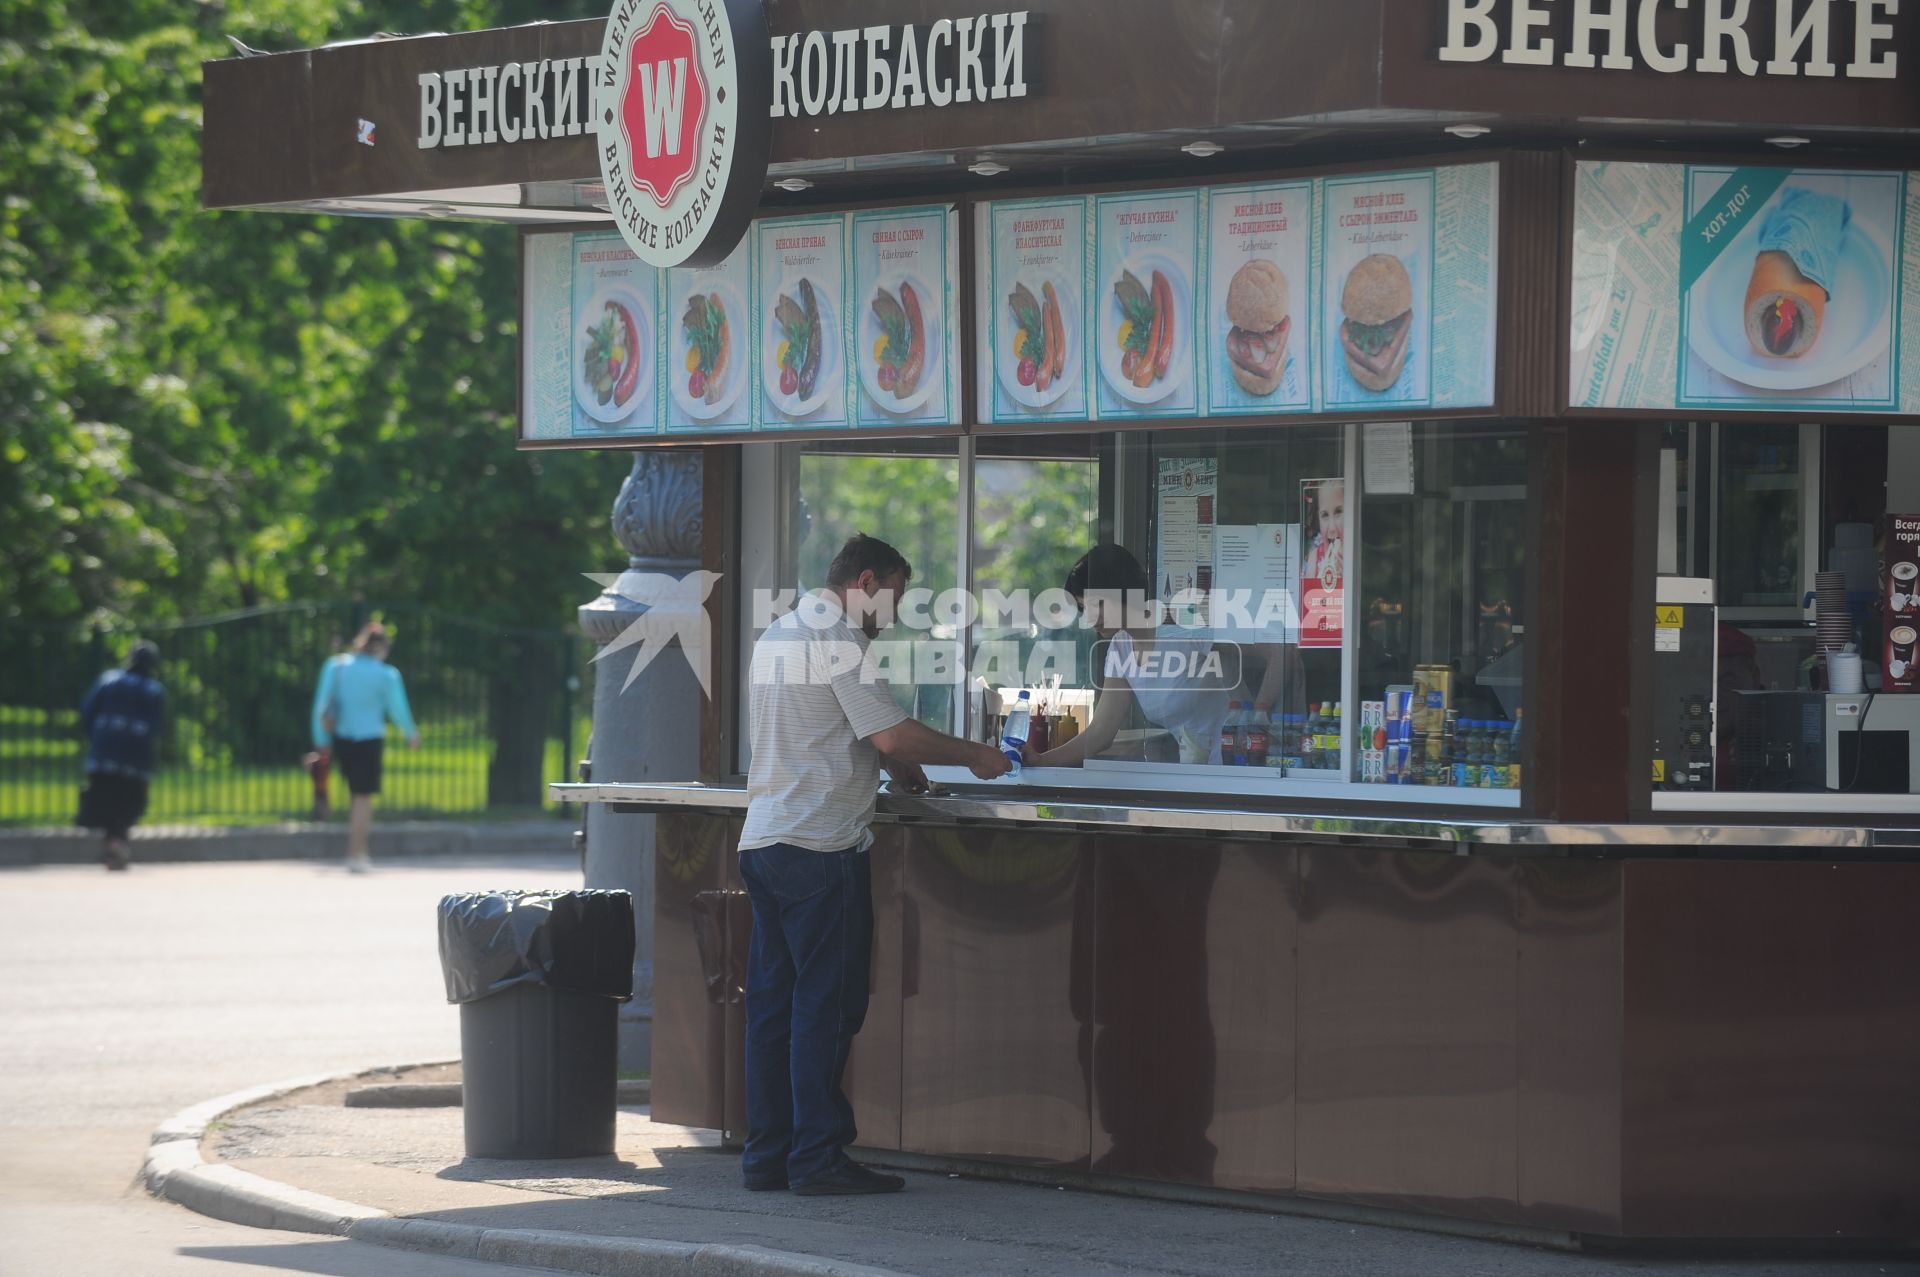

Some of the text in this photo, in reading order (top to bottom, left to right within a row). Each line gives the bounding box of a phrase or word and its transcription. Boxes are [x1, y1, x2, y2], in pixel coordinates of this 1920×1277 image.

[1439, 0, 1898, 79] ВЕНСКИЕ
[769, 11, 1028, 119] КОЛБАСКИ
[638, 57, 688, 158] W
[605, 121, 727, 250] ВЕНСКИЕ КОЛБАСКИ
[1234, 202, 1283, 217] МЯСНОЙ ХЛЕБ
[1353, 193, 1385, 208] МЯСНОЙ
[1346, 212, 1372, 227] СЫРОМ
[1701, 184, 1752, 244] ХОТ-ДОГ
[902, 229, 924, 241] СЫРОМ
[1228, 218, 1288, 236] ТРАДИЦИОННЫЙ
[1015, 235, 1062, 249] КЛАССИЧЕСКАЯ
